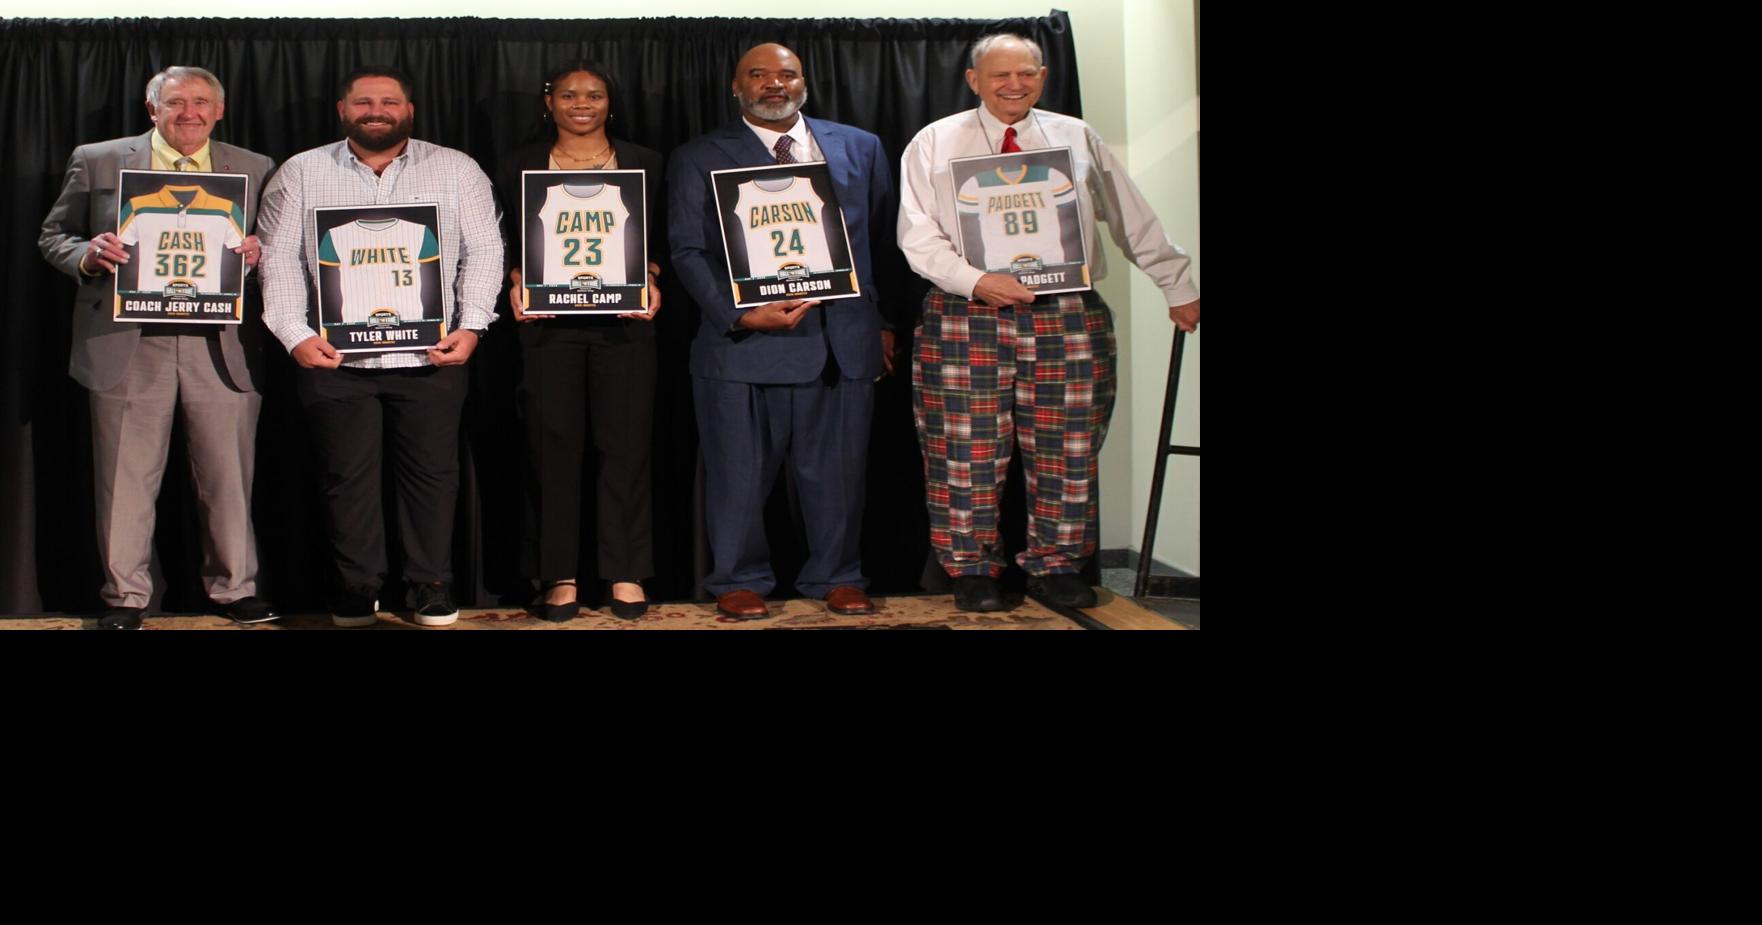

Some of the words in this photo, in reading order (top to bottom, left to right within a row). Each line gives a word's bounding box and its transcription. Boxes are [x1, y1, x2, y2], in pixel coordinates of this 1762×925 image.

[987, 191, 1046, 214] PADGETT
[556, 211, 615, 234] CAMP
[750, 202, 817, 229] CARSON
[1004, 210, 1039, 236] 89
[158, 231, 205, 251] CASH
[771, 228, 805, 257] 24
[350, 247, 411, 267] WHITE
[563, 238, 602, 266] 23
[155, 253, 206, 278] 362
[391, 269, 413, 287] 13
[759, 283, 787, 296] DION
[789, 280, 831, 292] CARSON
[1020, 272, 1066, 285] PADGETT
[125, 300, 161, 312] COACH
[165, 301, 200, 312] JERRY
[203, 302, 232, 313] CASH
[549, 293, 589, 304] RACHEL
[592, 293, 622, 304] CAMP
[349, 330, 383, 342] TYLER
[386, 329, 418, 340] WHITE
